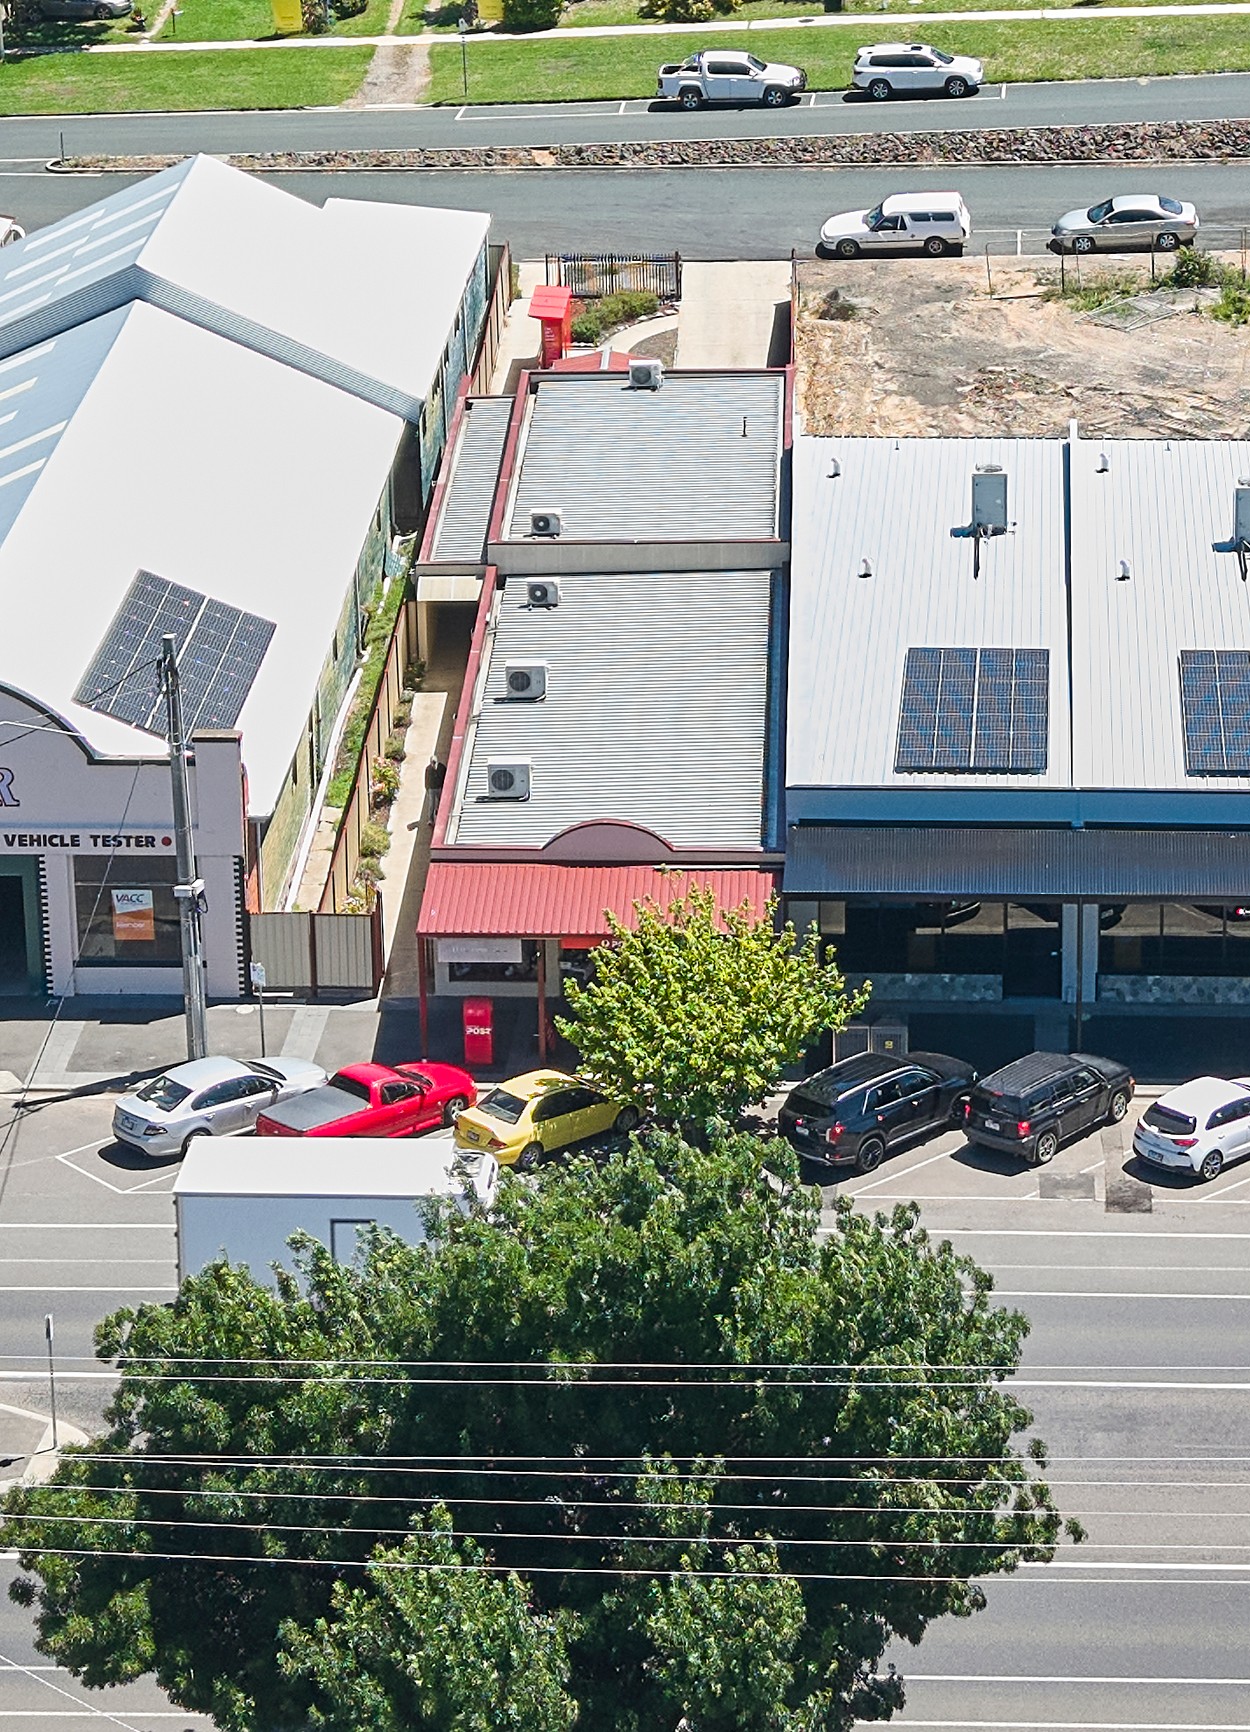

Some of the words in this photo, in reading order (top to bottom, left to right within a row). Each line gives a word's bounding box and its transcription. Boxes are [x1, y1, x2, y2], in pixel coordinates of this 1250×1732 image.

[3, 834, 80, 847] VEHICLE
[90, 834, 156, 848] TESTER
[116, 894, 144, 903] VACC
